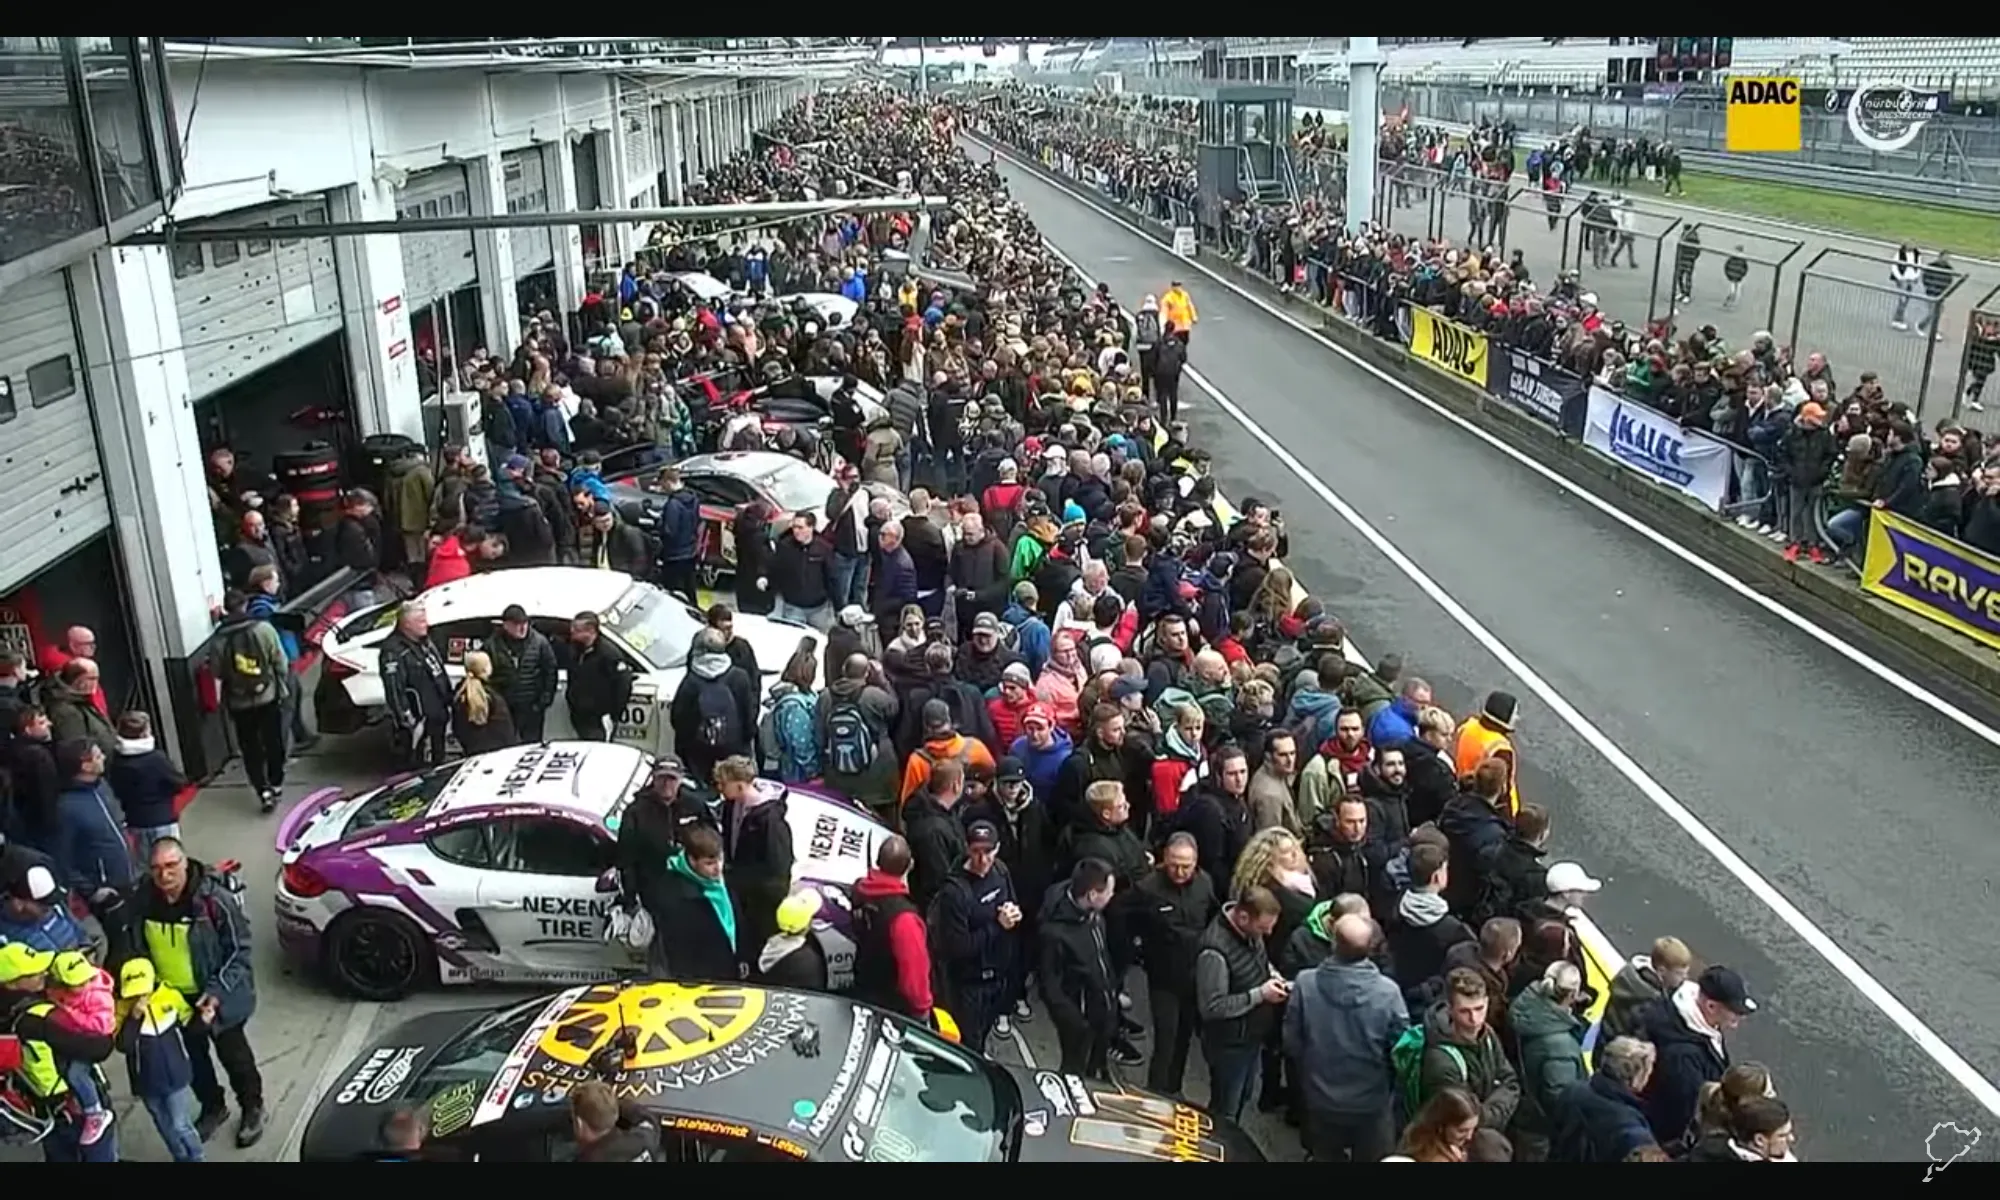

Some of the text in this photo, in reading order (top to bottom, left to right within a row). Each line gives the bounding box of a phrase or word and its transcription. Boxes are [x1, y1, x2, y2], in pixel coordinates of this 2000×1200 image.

[1431, 318, 1476, 375] ADAC
[497, 747, 548, 798] NEXEN
[537, 751, 579, 784] TIRE
[808, 814, 839, 862] NEXEN
[838, 826, 864, 859] TIRE
[522, 895, 605, 919] NEXEN
[537, 917, 593, 938] TIRE
[336, 1049, 395, 1104] BAHCO
